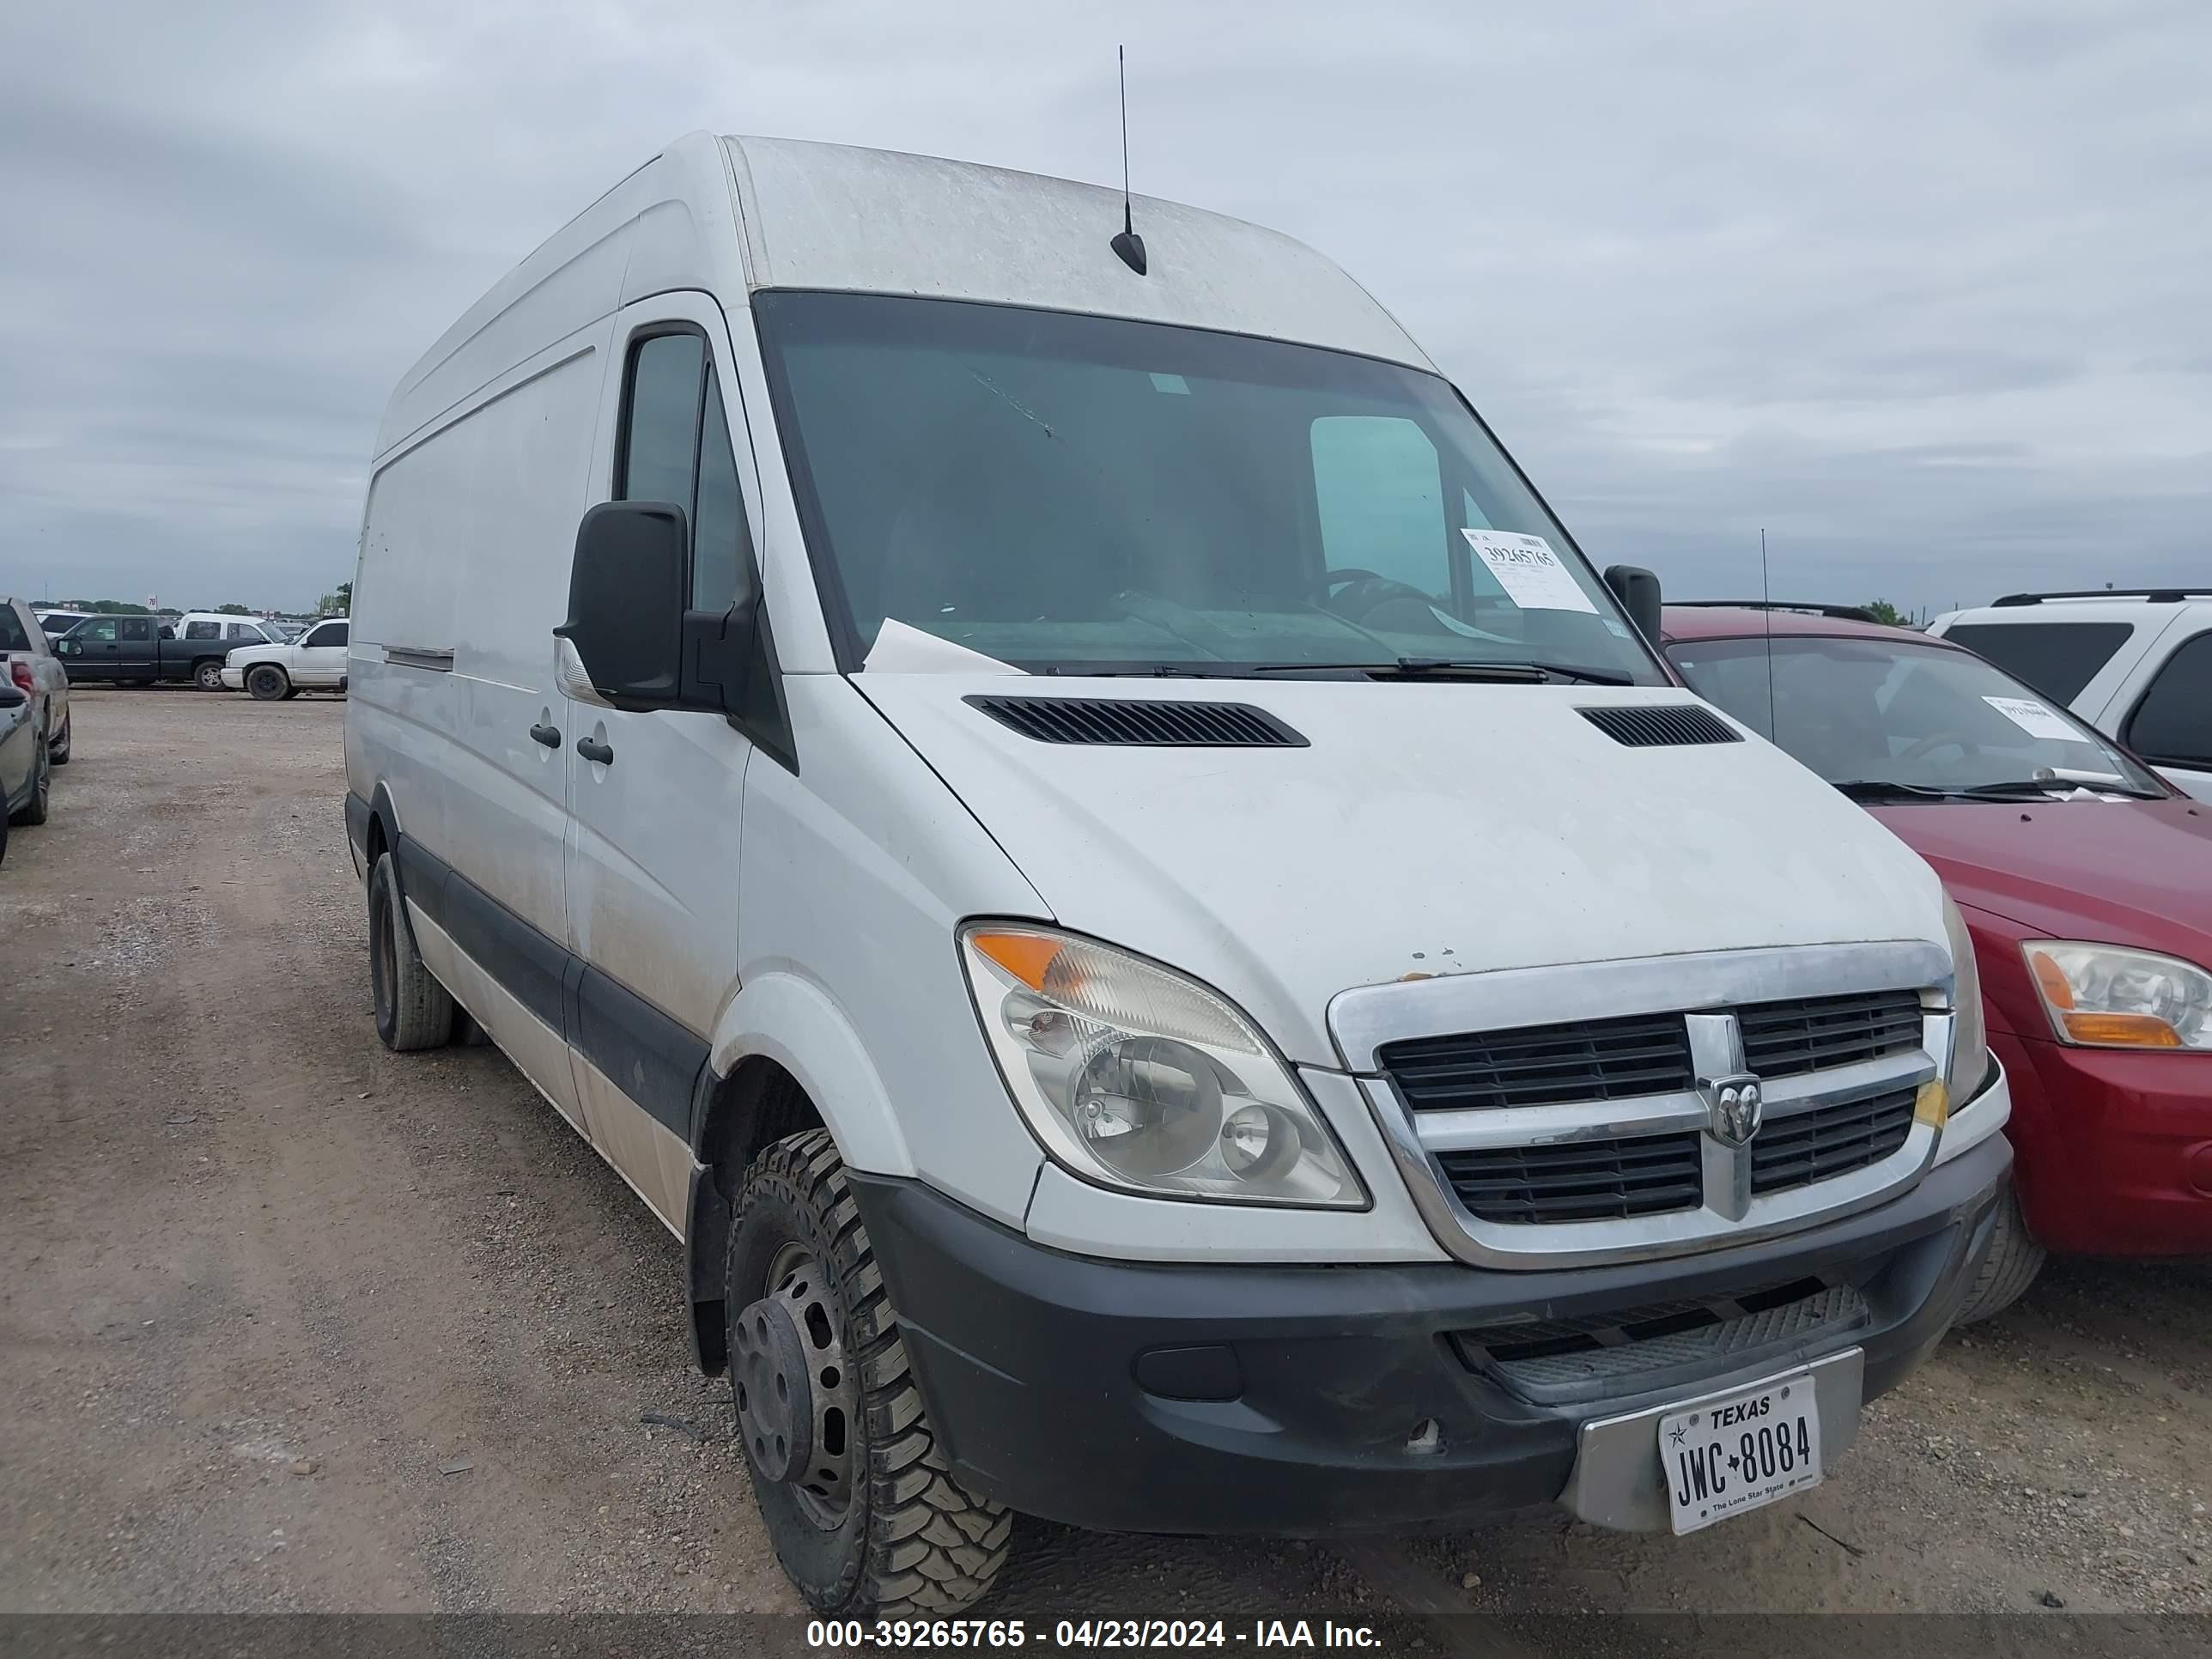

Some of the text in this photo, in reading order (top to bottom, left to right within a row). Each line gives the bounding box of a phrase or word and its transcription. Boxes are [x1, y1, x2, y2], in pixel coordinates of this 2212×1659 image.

[1484, 546, 1554, 567] 39265765
[1711, 1396, 1771, 1430] TEXAS
[1678, 1416, 1810, 1507] JWC 8084
[1712, 1483, 1784, 1512] The Lone Star State
